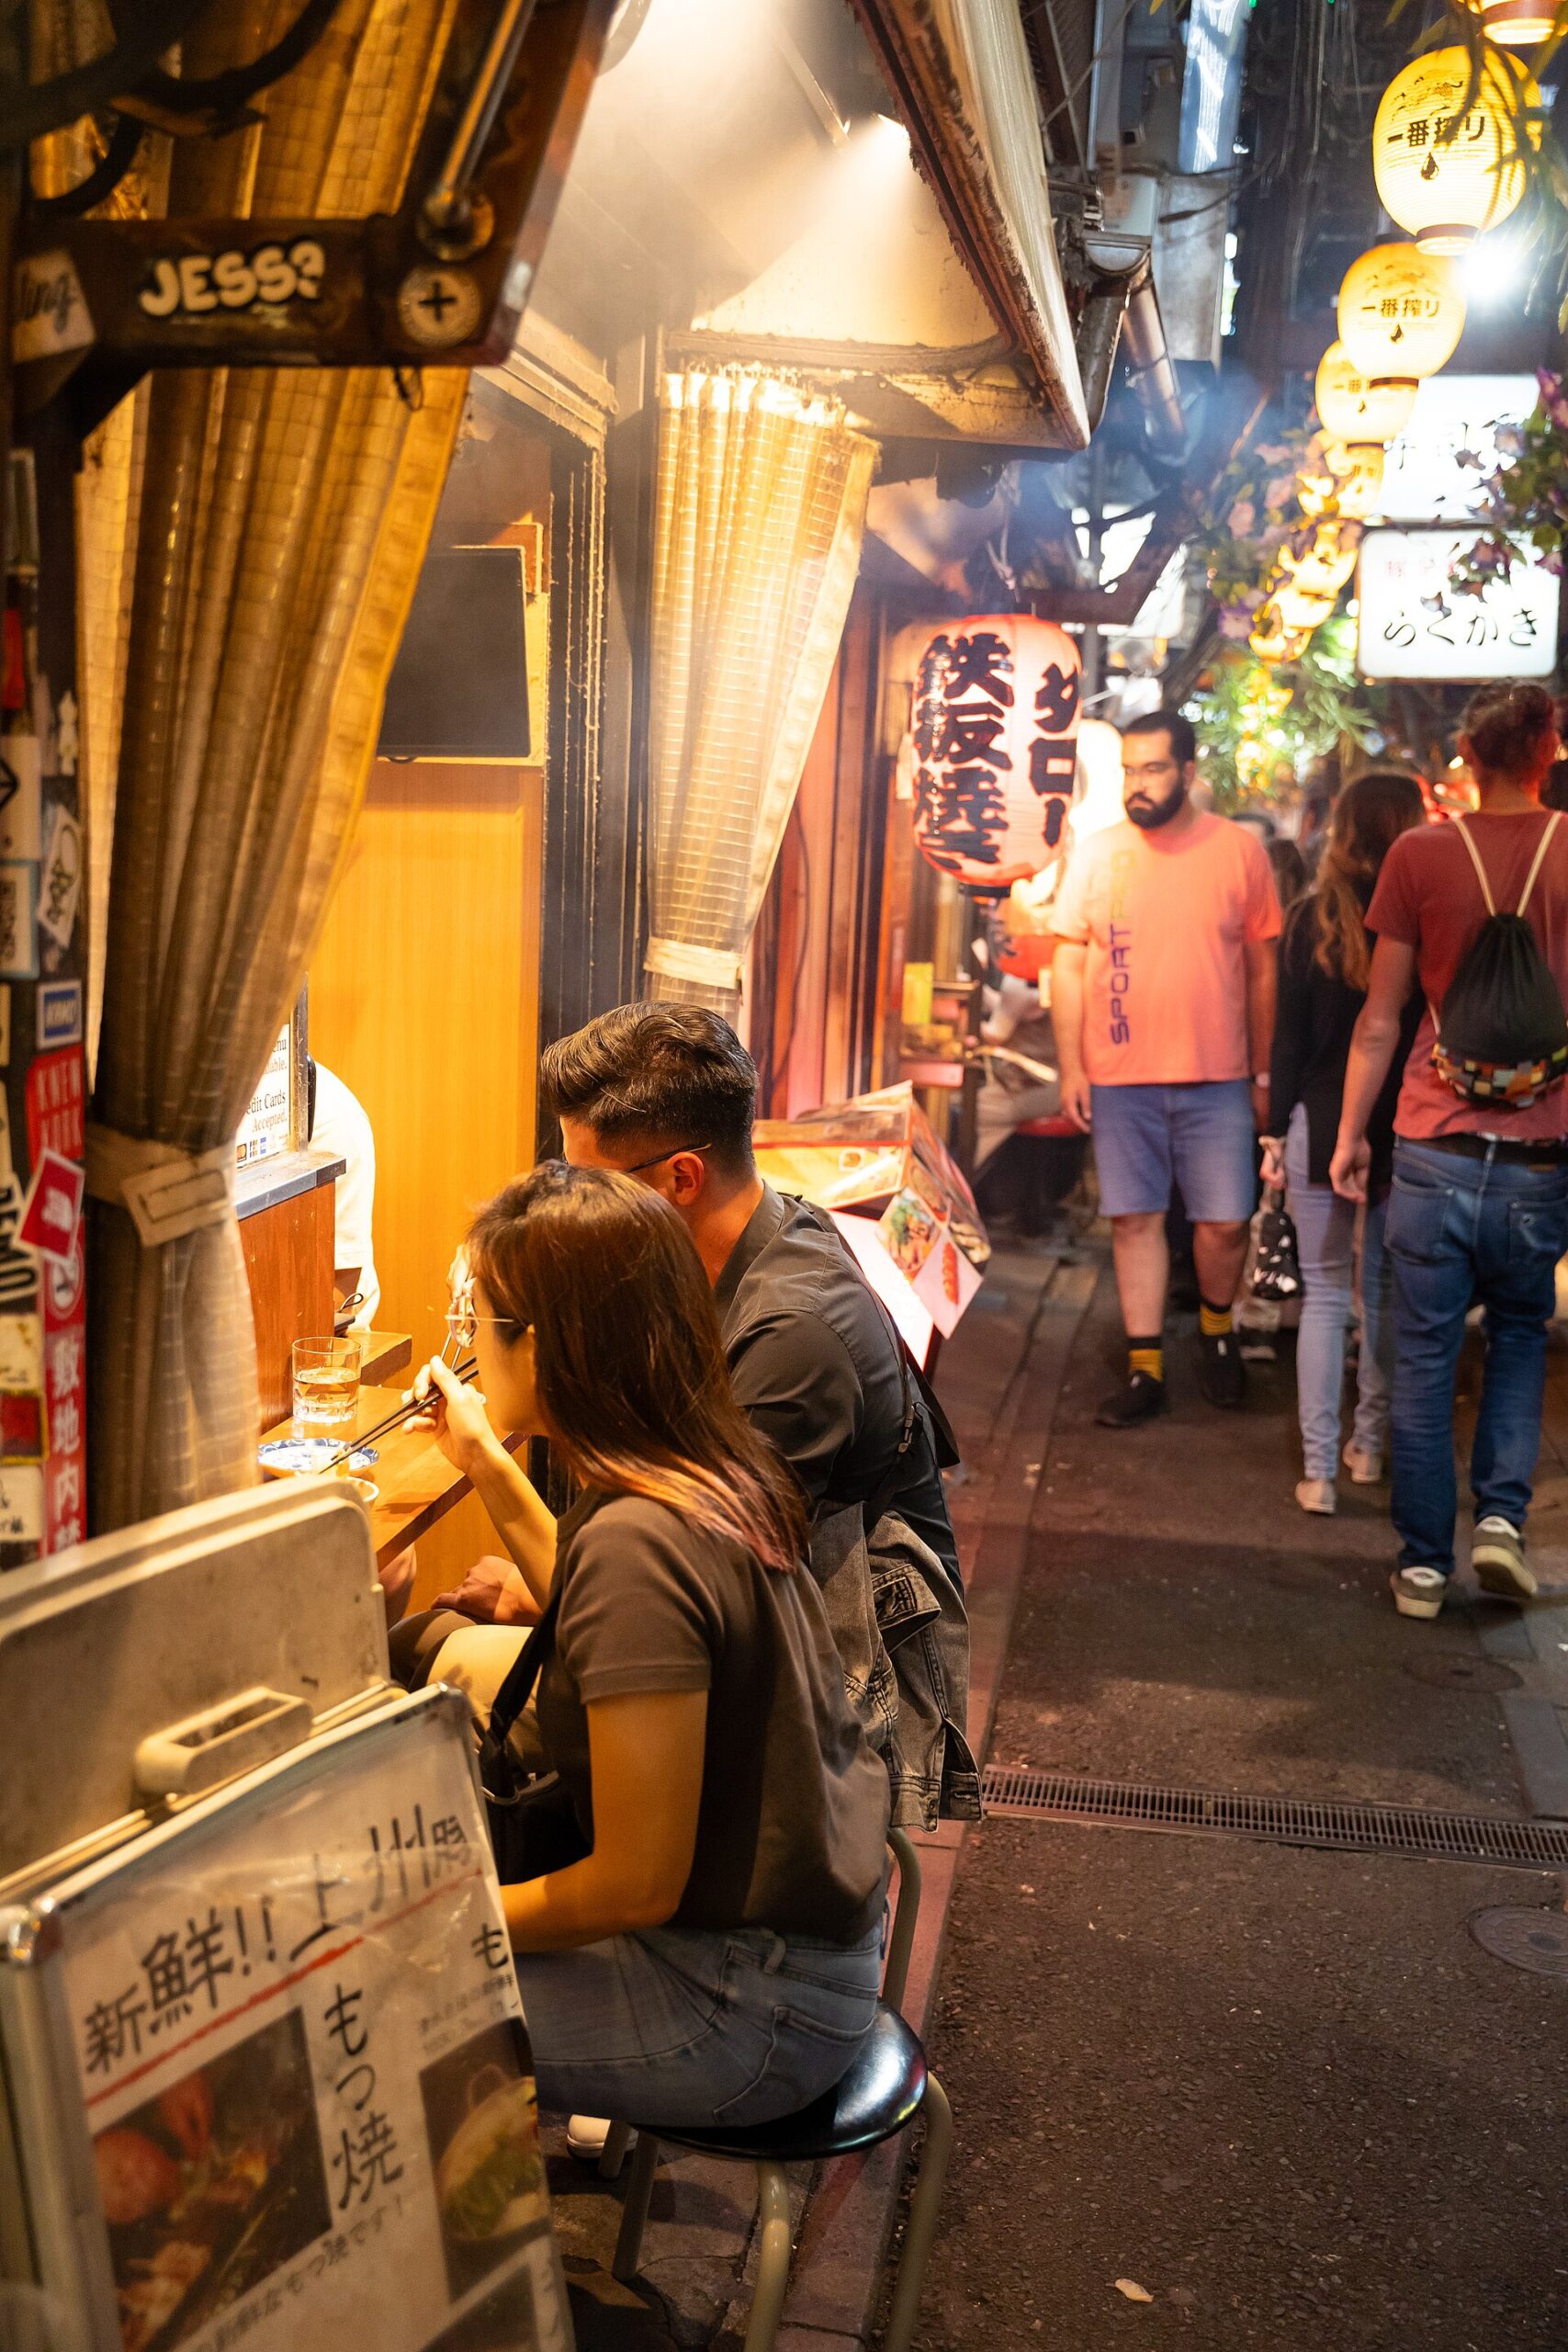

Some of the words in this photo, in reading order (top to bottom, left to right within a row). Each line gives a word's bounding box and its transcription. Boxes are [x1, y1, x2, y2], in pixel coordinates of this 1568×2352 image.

[1110, 923, 1131, 1045] SPORT
[272, 1038, 287, 1053] enu
[246, 1096, 263, 1115] edit
[264, 1090, 286, 1110] Cards
[252, 1109, 288, 1133] Accepted.
[323, 1983, 404, 2210] もつ焼
